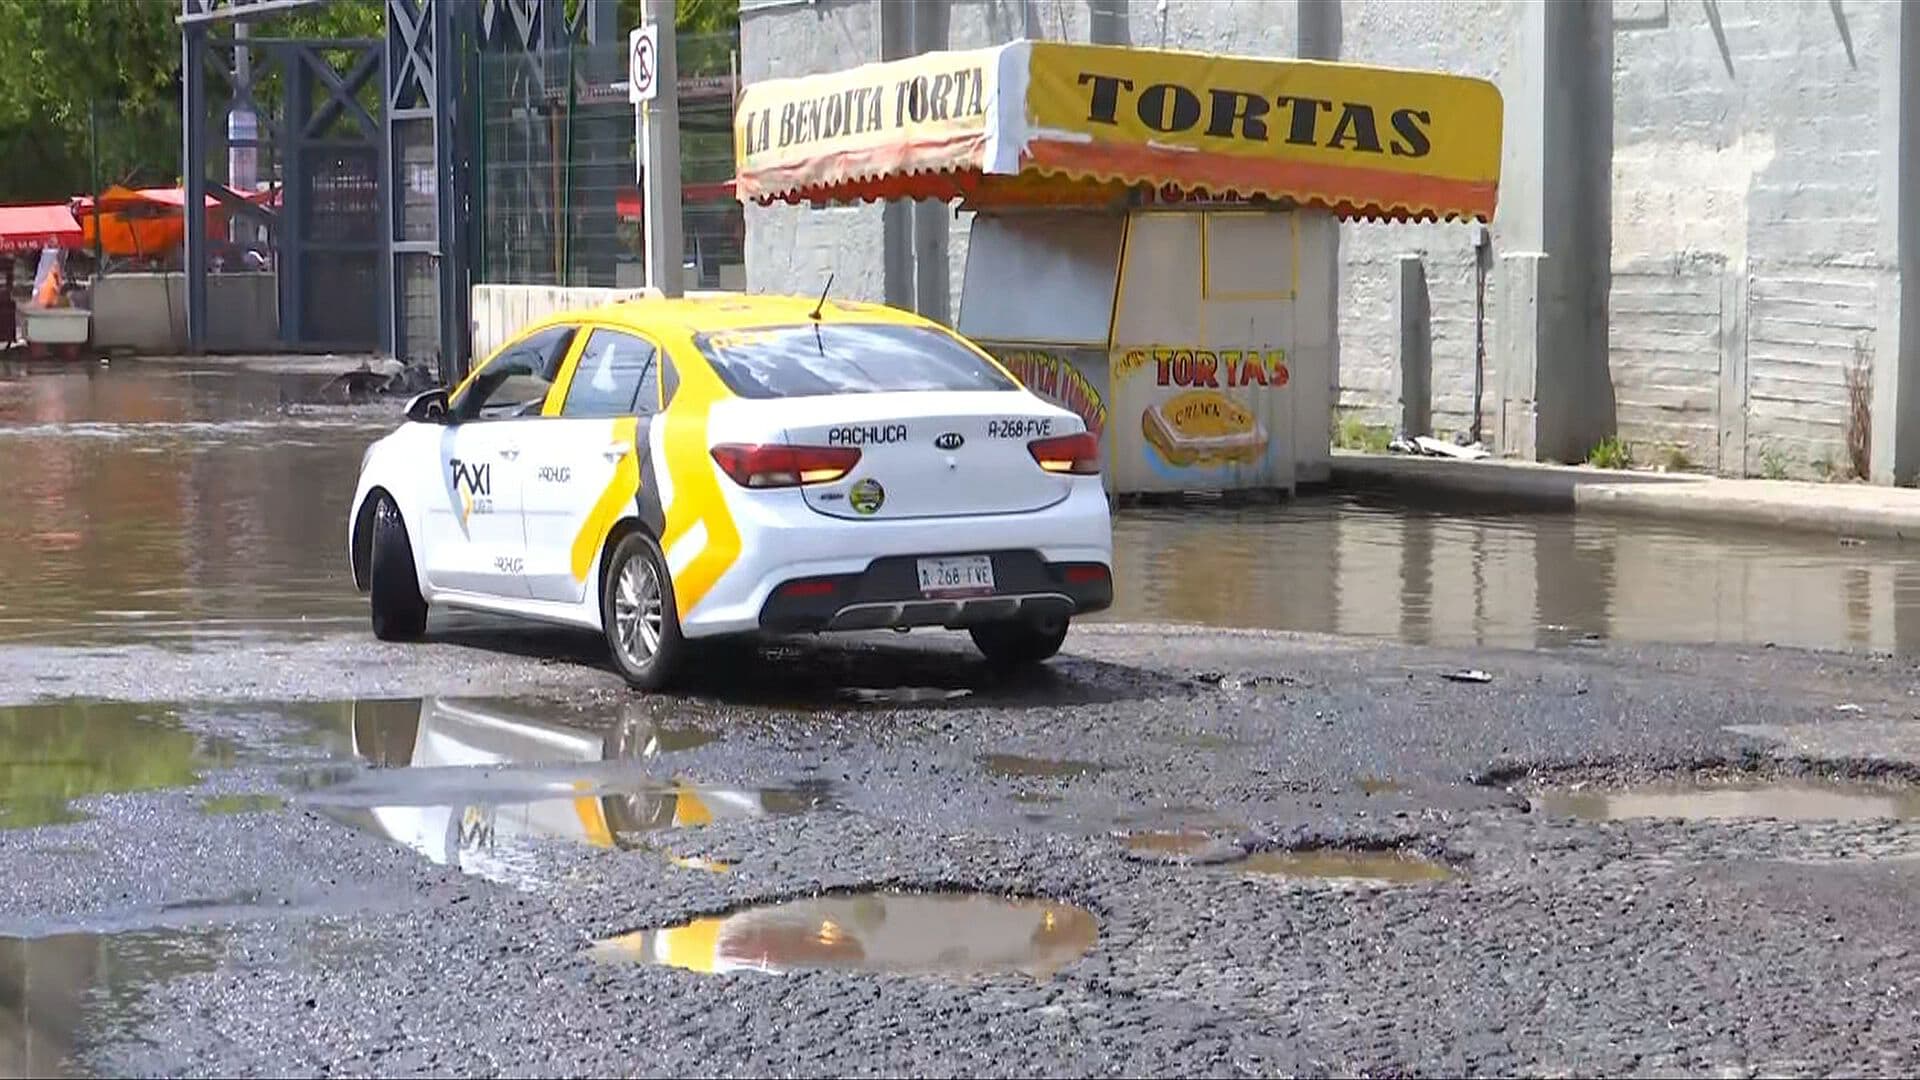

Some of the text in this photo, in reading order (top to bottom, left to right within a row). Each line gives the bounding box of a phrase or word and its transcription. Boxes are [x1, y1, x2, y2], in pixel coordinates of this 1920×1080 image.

[746, 67, 983, 155] LA BENDITA TORTA
[1077, 71, 1432, 158] TORTAS
[1153, 348, 1290, 388] TORTAS
[828, 424, 908, 445] PACHUCA
[939, 433, 963, 447] KIA
[449, 458, 491, 496] TAXI
